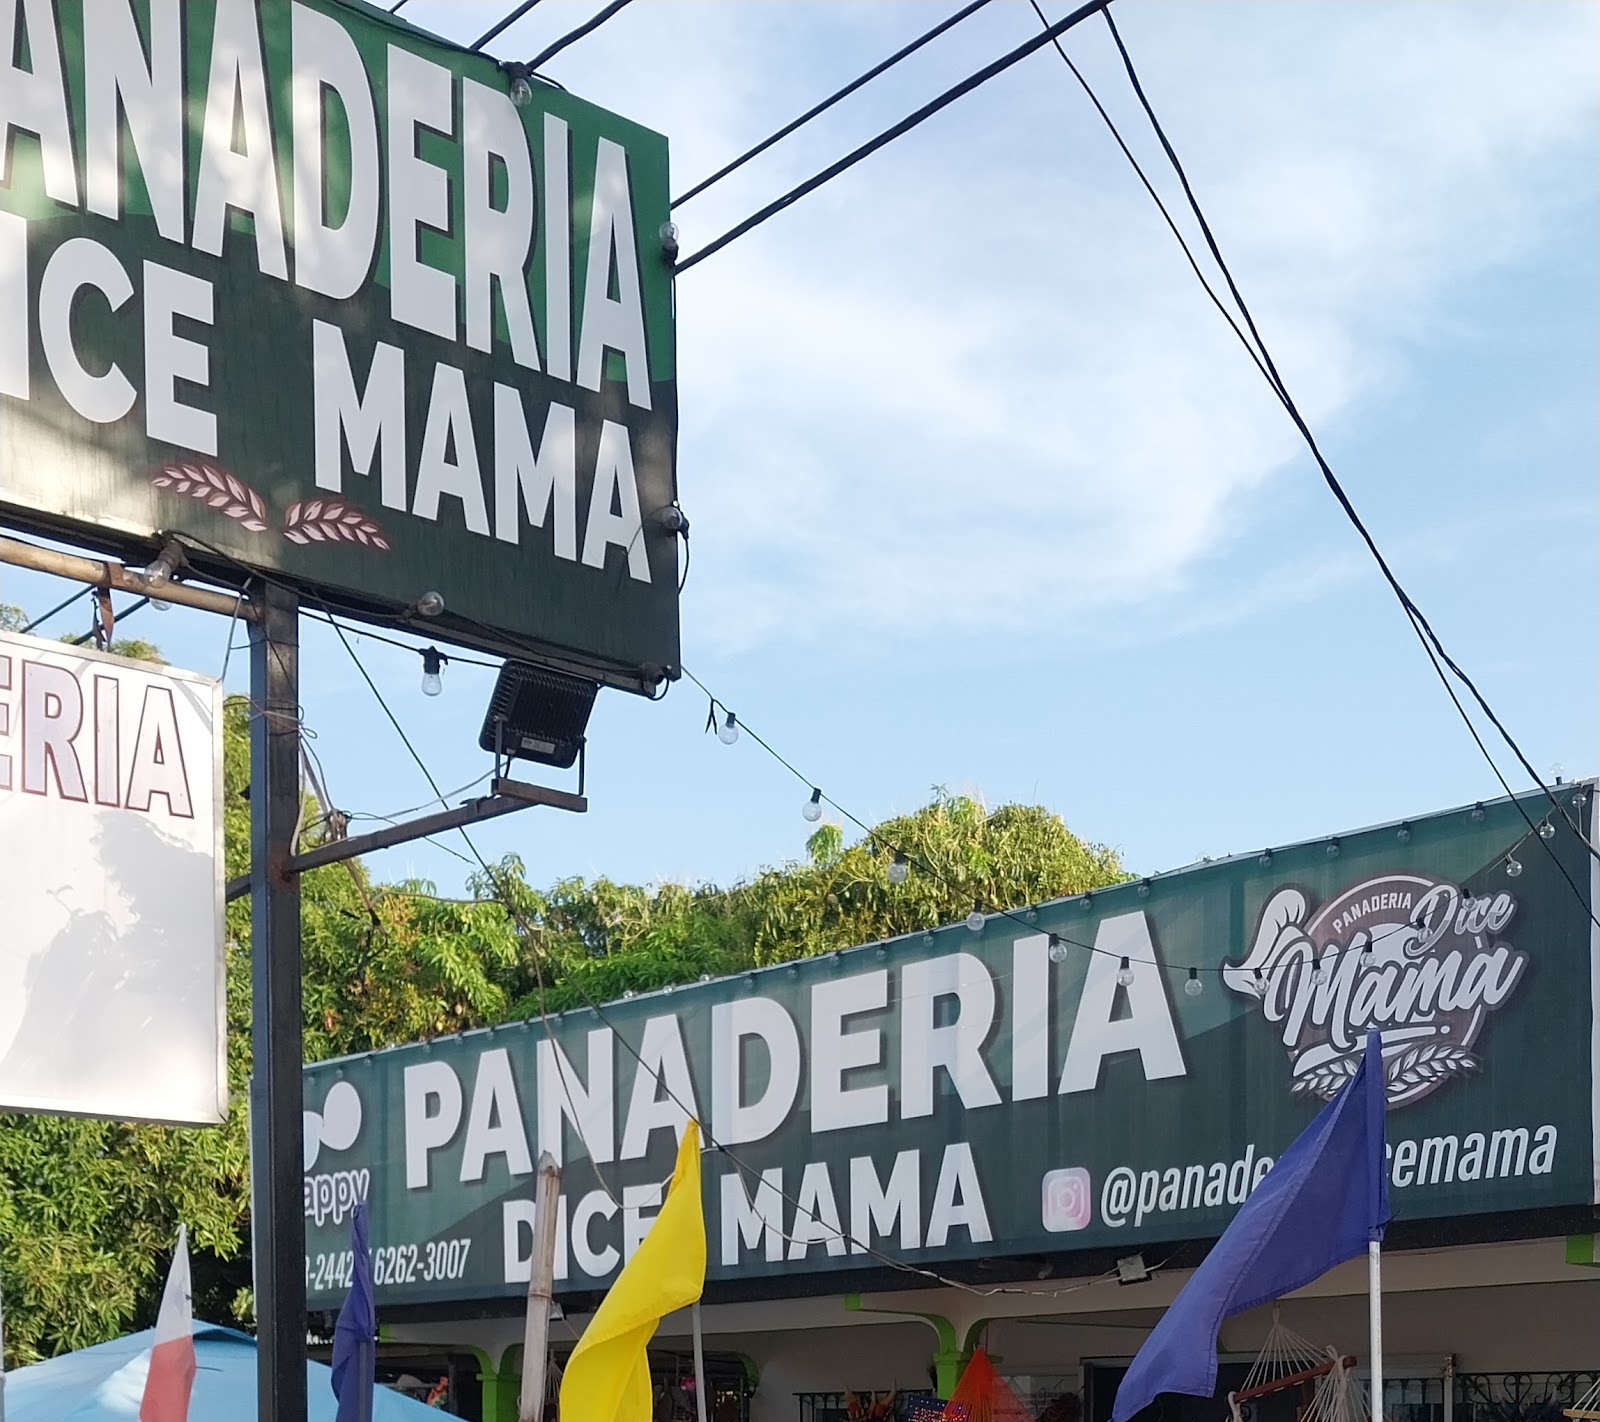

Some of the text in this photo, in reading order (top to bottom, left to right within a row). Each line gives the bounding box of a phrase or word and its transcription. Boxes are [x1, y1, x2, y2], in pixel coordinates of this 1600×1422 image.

[312, 318, 652, 583] MAMA
[1332, 884, 1515, 957] PANADERIA Dice
[1264, 929, 1524, 1047] Mama
[403, 910, 1187, 1190] PANADERIA
[373, 1238, 472, 1286] 6262-3007
[720, 1142, 994, 1266] MAMA
